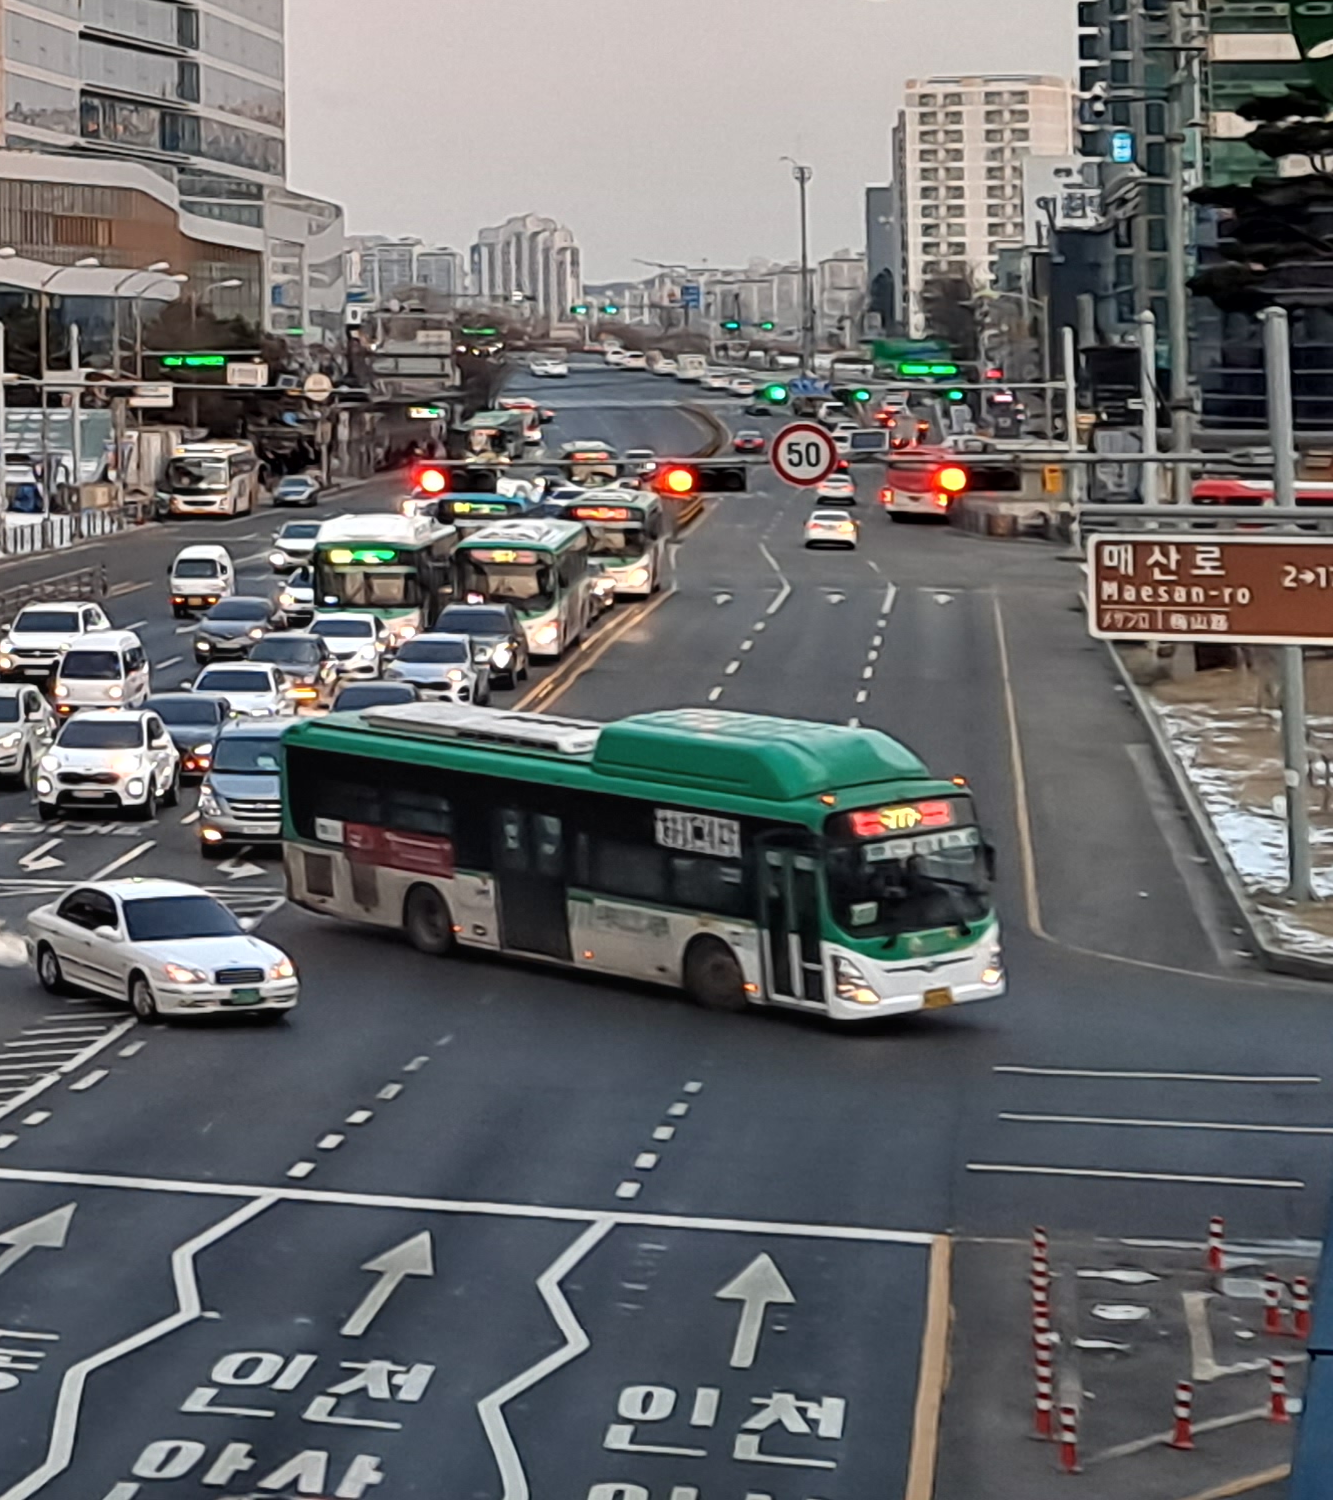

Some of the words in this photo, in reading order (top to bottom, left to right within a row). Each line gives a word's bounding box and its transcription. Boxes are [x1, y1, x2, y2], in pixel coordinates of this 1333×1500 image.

[787, 441, 822, 468] 50
[1101, 544, 1226, 581] 매산로
[1100, 579, 1251, 605] Maesan-ro
[179, 1350, 436, 1430] 인천
[602, 1384, 846, 1469] 인천
